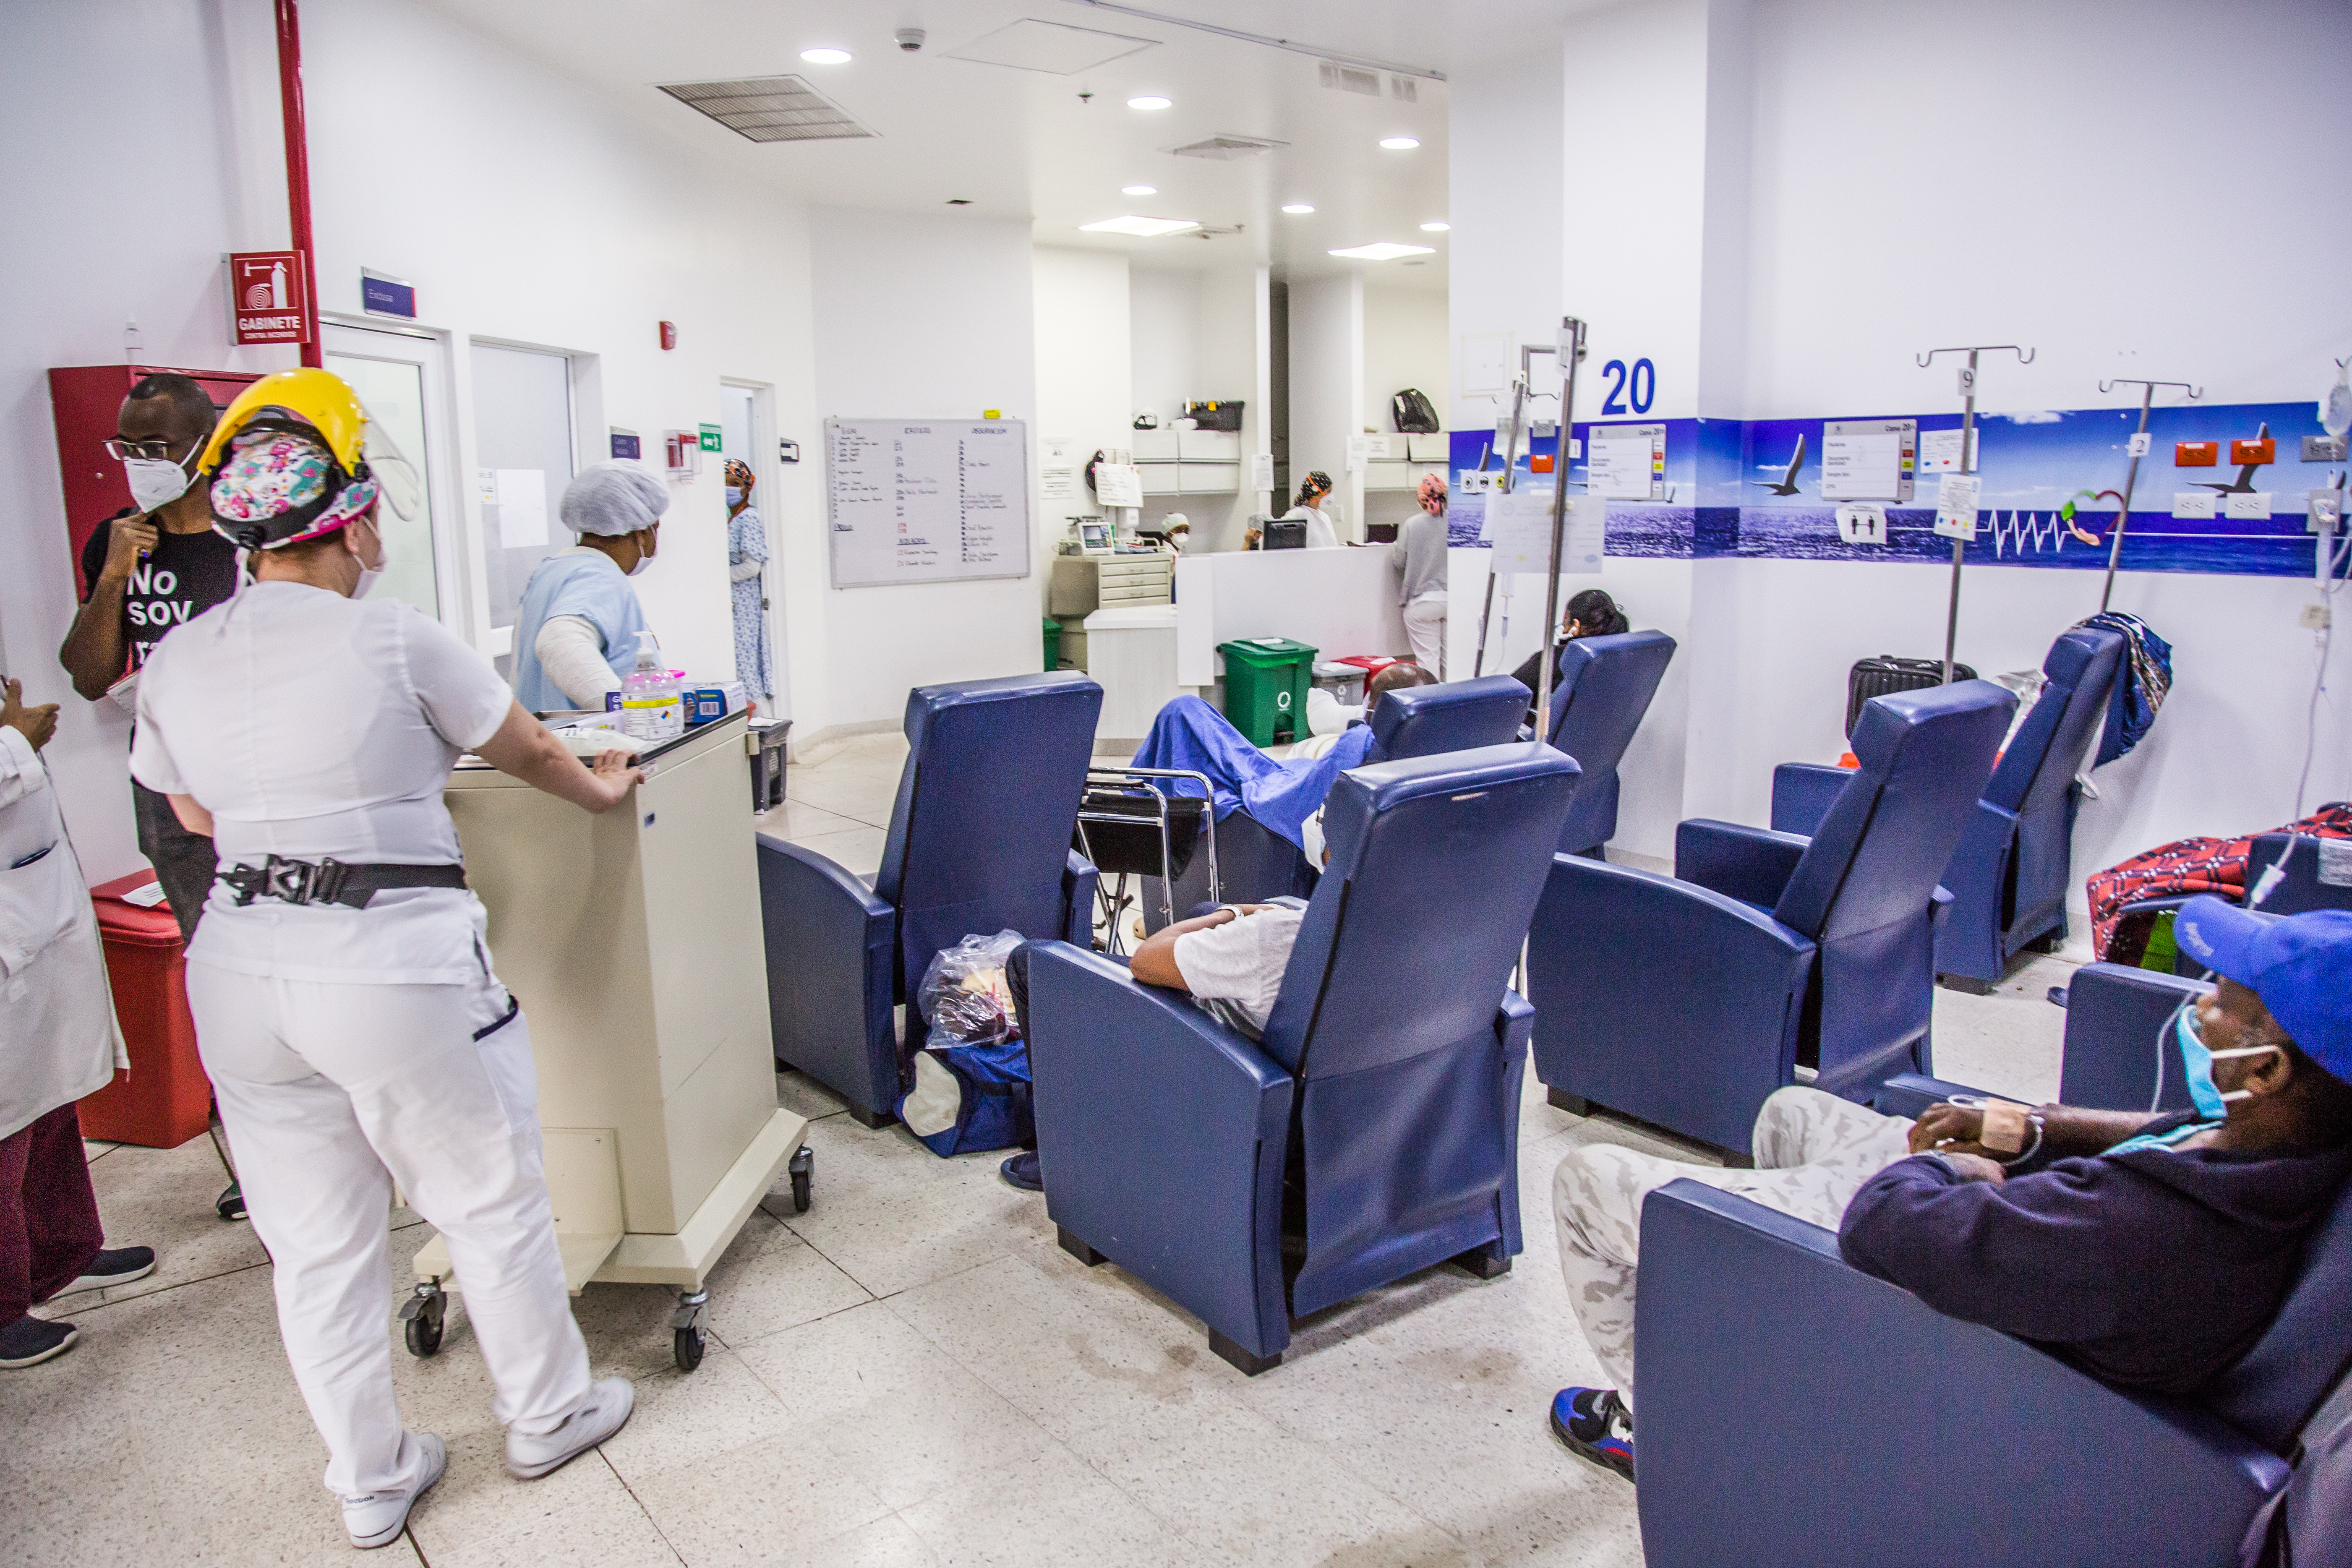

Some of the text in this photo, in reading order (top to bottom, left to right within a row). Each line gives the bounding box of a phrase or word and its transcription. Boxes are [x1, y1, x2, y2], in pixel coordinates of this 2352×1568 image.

[238, 316, 301, 331] GABINETE
[1601, 357, 1655, 415] 20
[1963, 370, 1974, 389] 9
[2135, 439, 2145, 453] 2
[127, 563, 178, 595] NO
